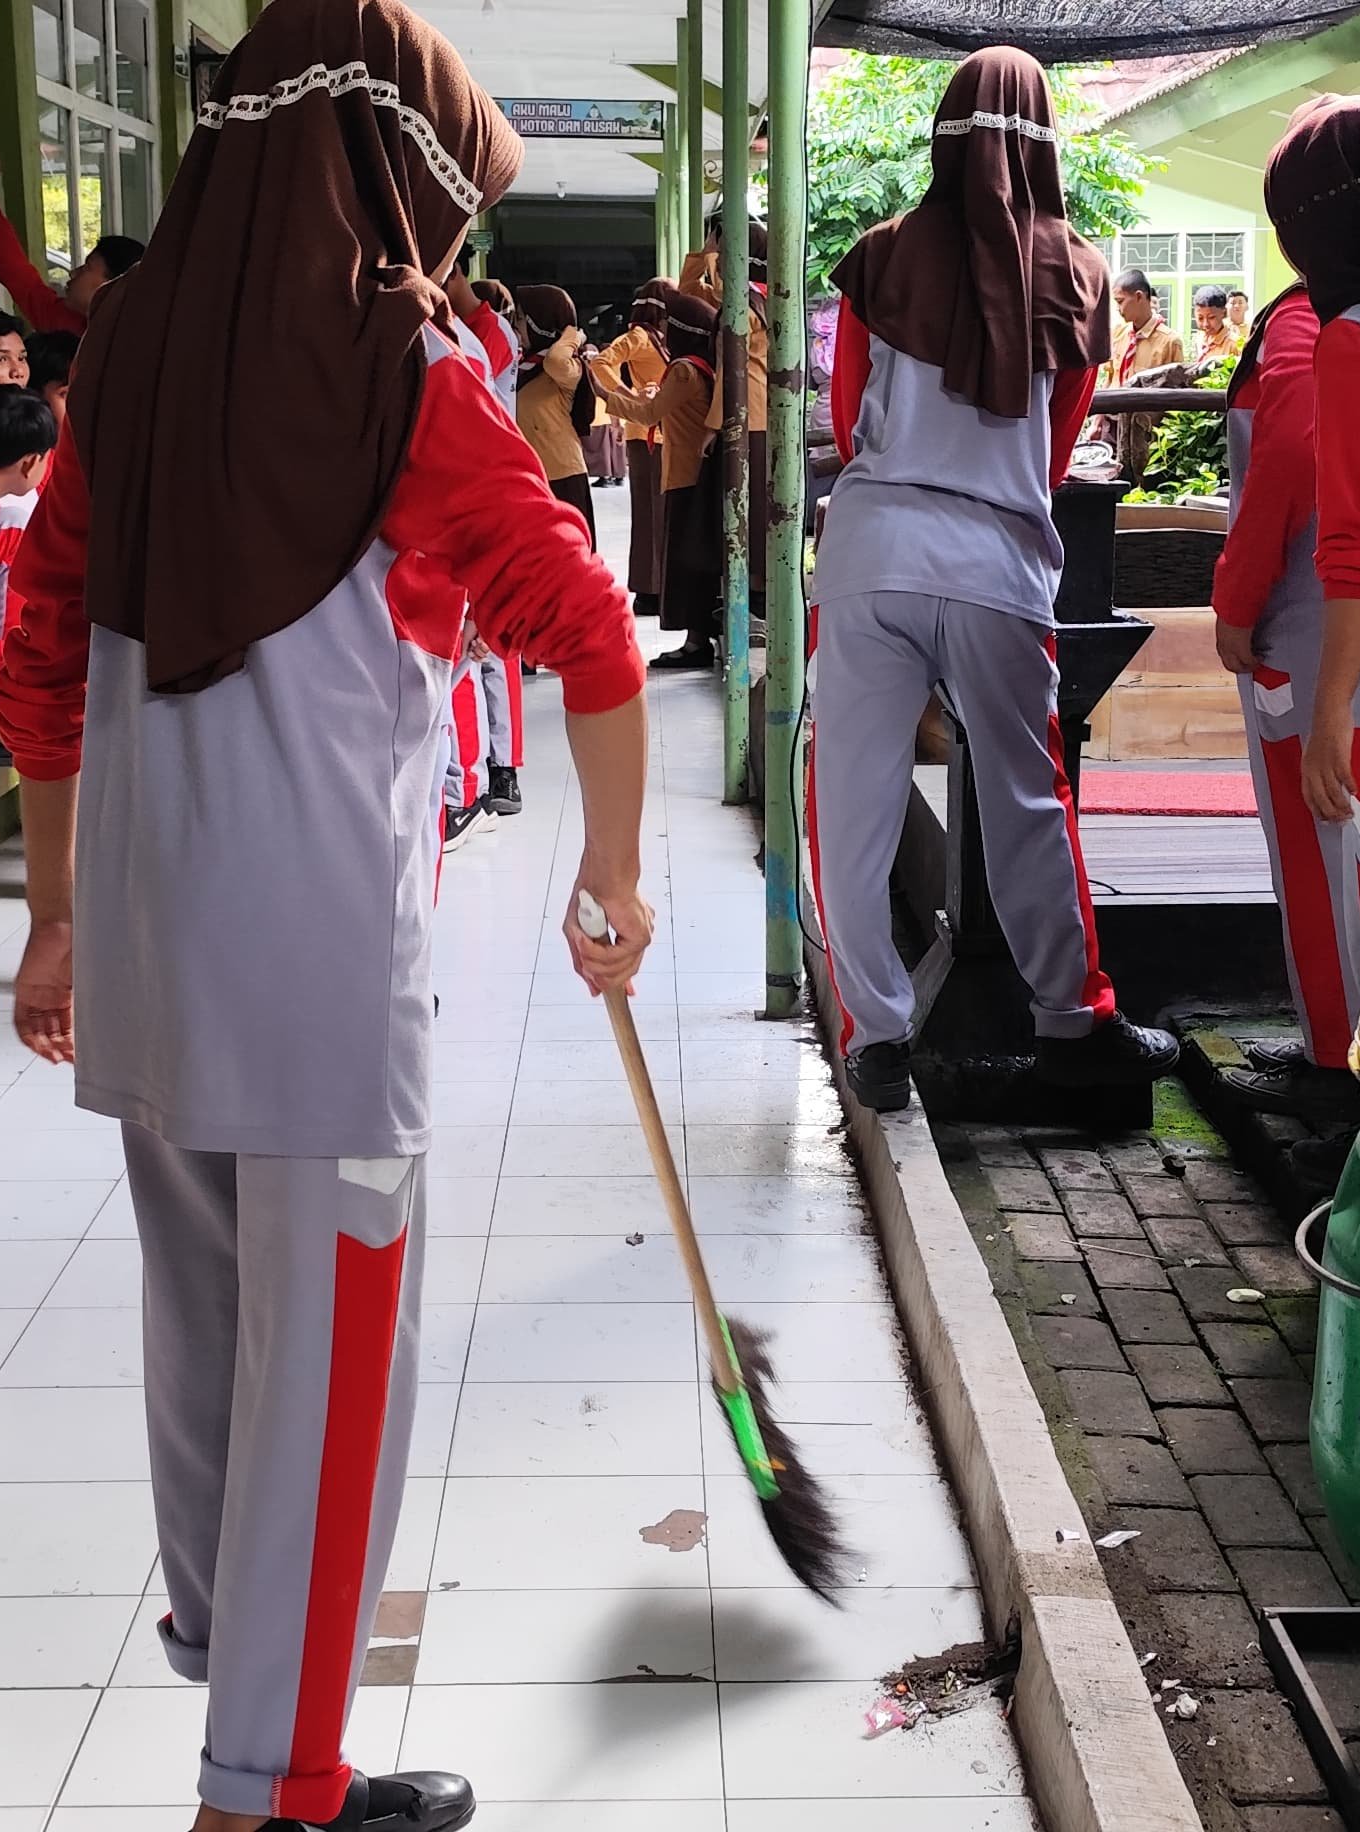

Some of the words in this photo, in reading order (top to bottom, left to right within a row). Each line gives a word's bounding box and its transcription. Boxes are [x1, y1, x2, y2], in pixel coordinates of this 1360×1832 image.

[512, 103, 535, 116] AKU
[538, 104, 571, 117] MALU
[520, 119, 556, 132] KOTOR
[558, 120, 581, 132] DAN
[583, 120, 620, 133] RUSAK
